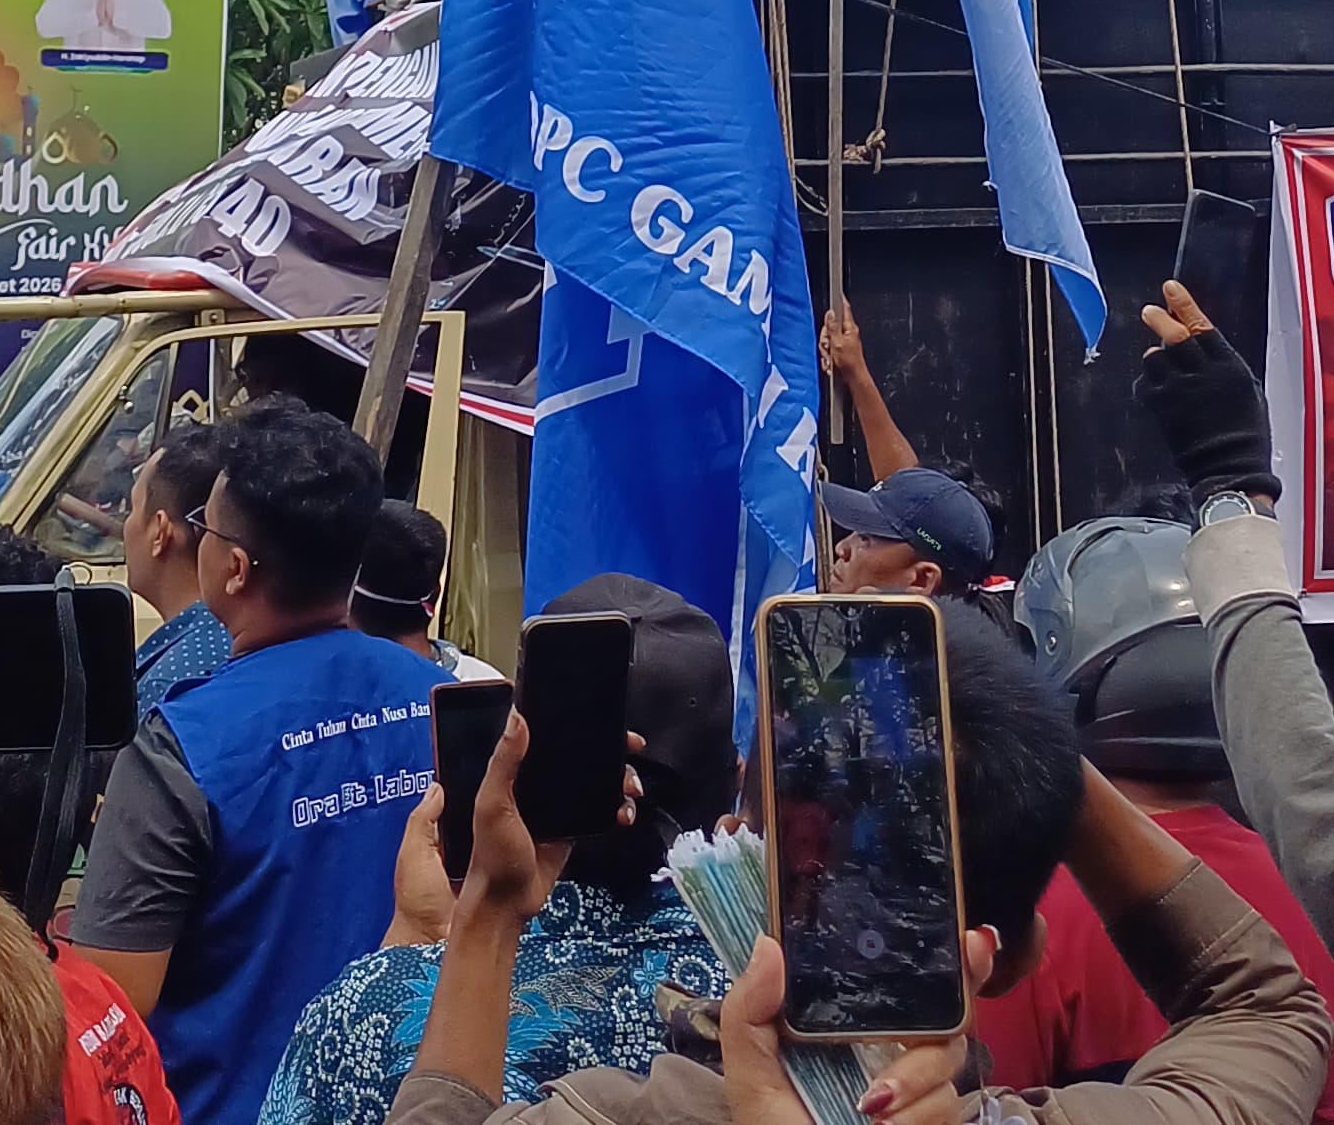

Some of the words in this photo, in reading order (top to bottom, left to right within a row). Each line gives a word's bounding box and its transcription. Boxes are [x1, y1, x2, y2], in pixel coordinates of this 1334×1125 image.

[19, 277, 62, 293] 2026
[282, 730, 314, 751] Cinta
[317, 719, 347, 740] Tuhan
[351, 712, 378, 730] Cinta
[381, 706, 408, 724] Nusa
[410, 701, 432, 718] Ban
[293, 793, 340, 828] Ora
[374, 769, 436, 804] Labo
